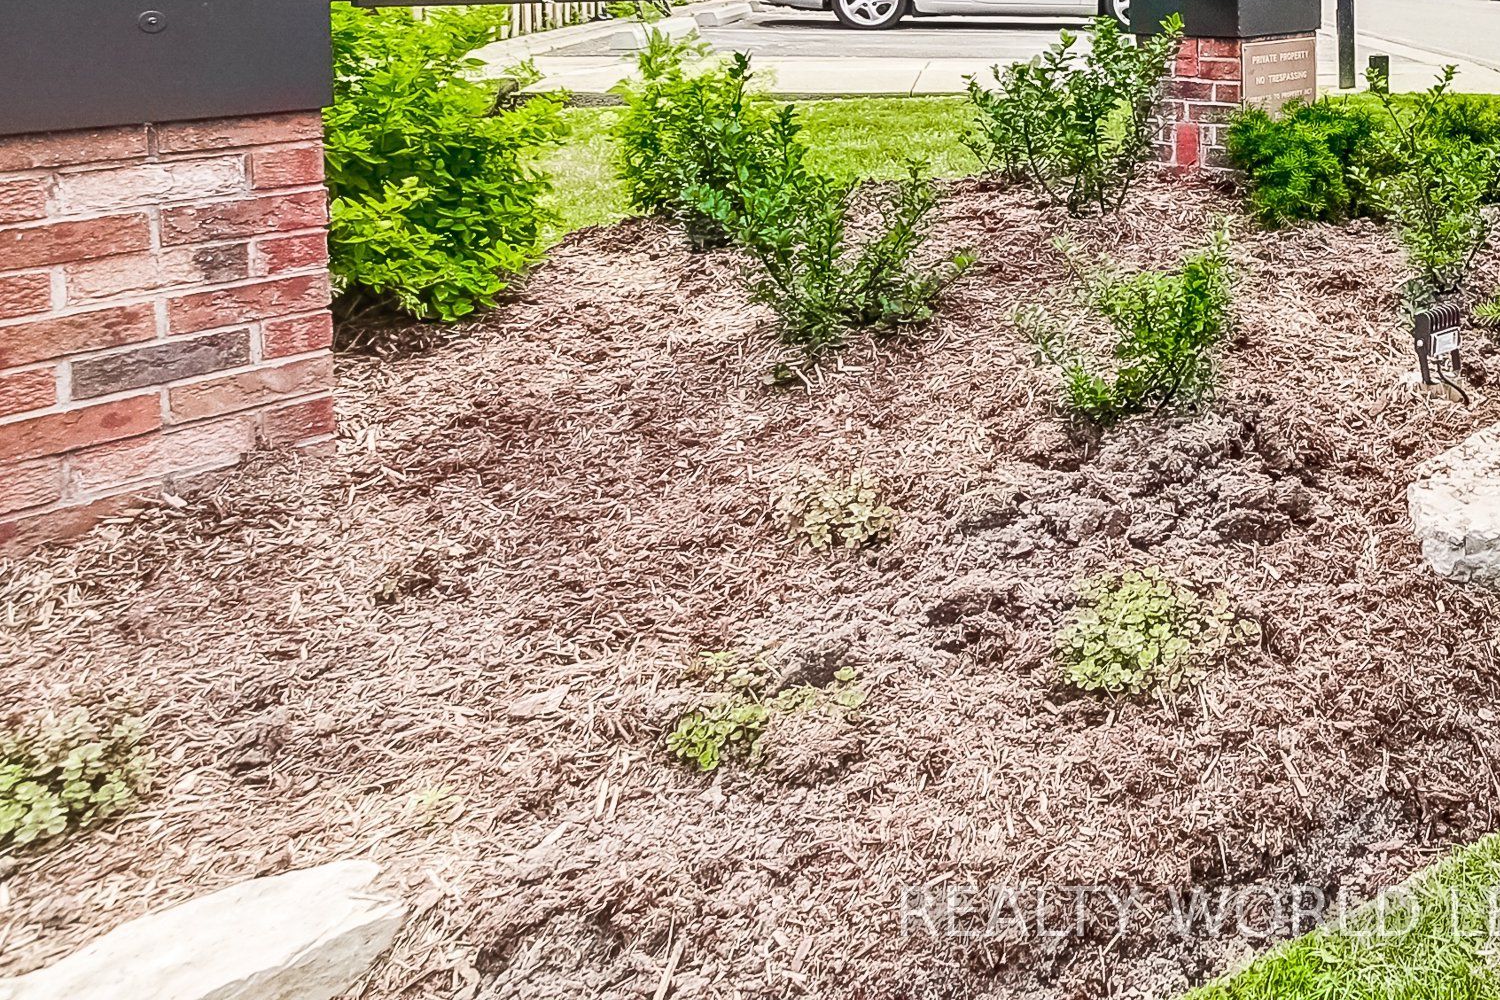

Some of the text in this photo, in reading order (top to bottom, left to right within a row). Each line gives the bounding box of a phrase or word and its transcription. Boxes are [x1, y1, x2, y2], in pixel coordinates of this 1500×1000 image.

[1252, 51, 1309, 64] PRIVATE PROPERTY
[1256, 71, 1307, 85] NO TRESPASSING
